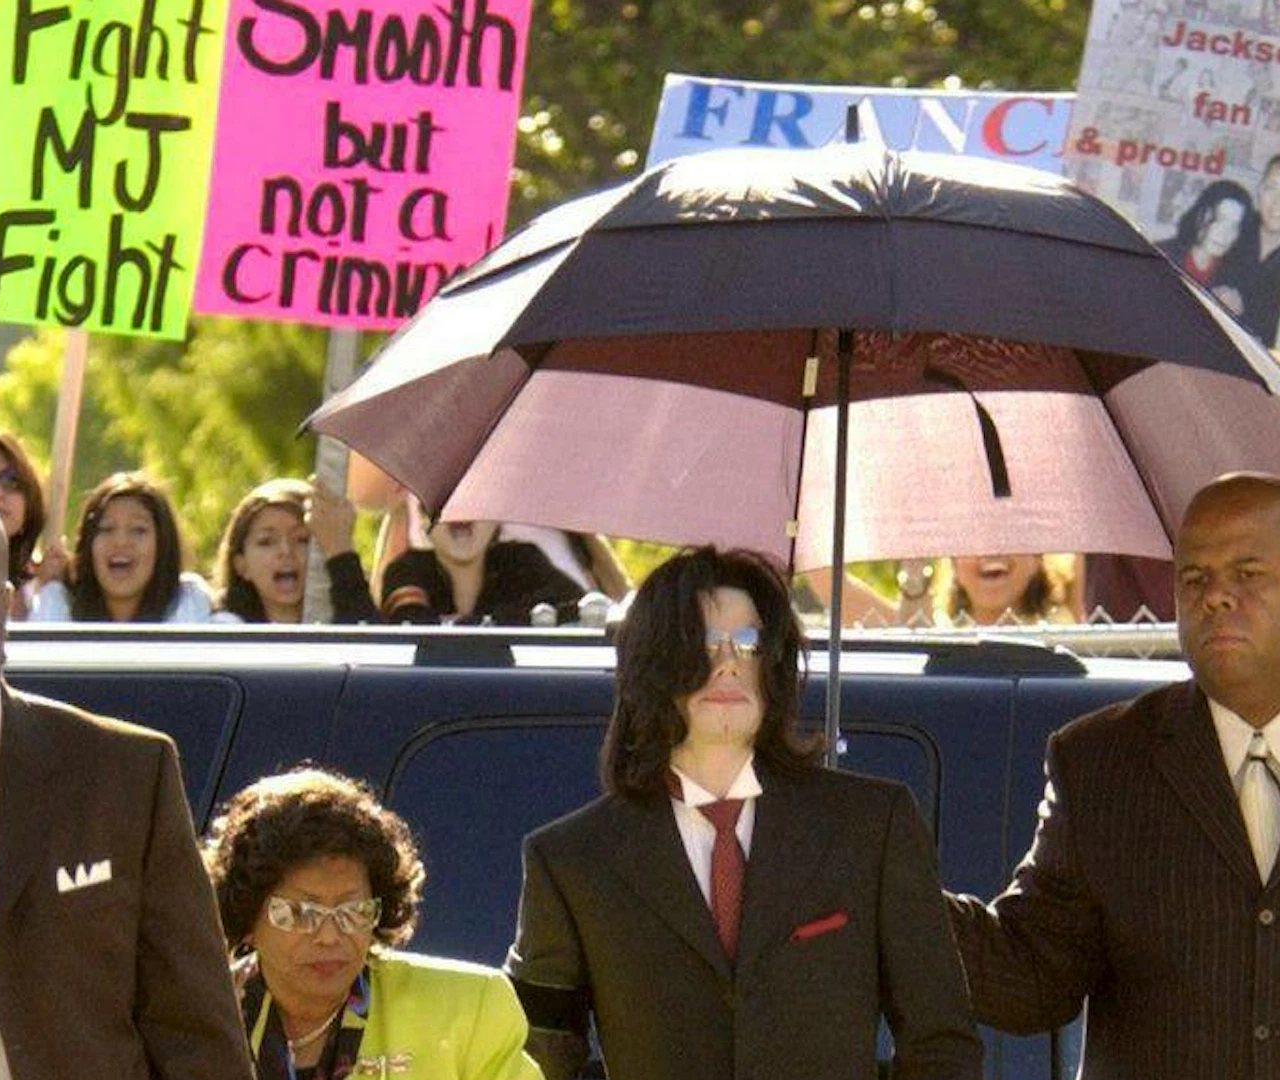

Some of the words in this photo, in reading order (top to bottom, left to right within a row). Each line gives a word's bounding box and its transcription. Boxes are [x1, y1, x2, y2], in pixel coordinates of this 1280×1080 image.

[13, 0, 215, 125] Fight
[323, 102, 444, 174] but
[676, 81, 1073, 157] FRANC
[1192, 91, 1252, 126] fan
[31, 106, 192, 212] MJ
[1076, 127, 1102, 156] &
[1115, 138, 1227, 176] proud
[260, 176, 381, 242] not
[398, 187, 453, 242] a
